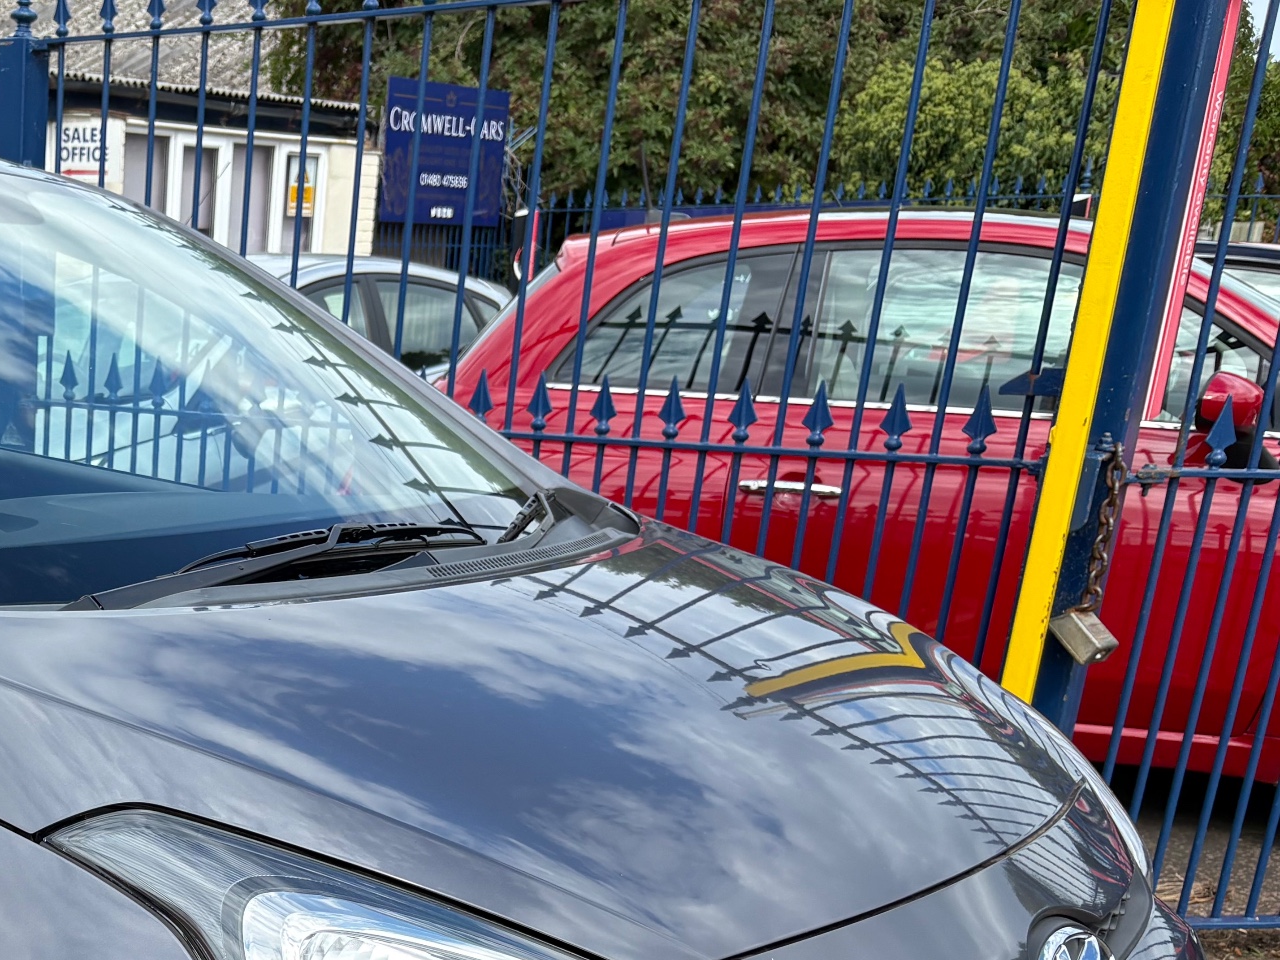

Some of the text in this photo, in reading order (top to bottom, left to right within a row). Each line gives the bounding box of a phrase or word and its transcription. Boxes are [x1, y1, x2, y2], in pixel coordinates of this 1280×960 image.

[62, 127, 102, 143] SALE
[1180, 91, 1224, 286] Warranty available
